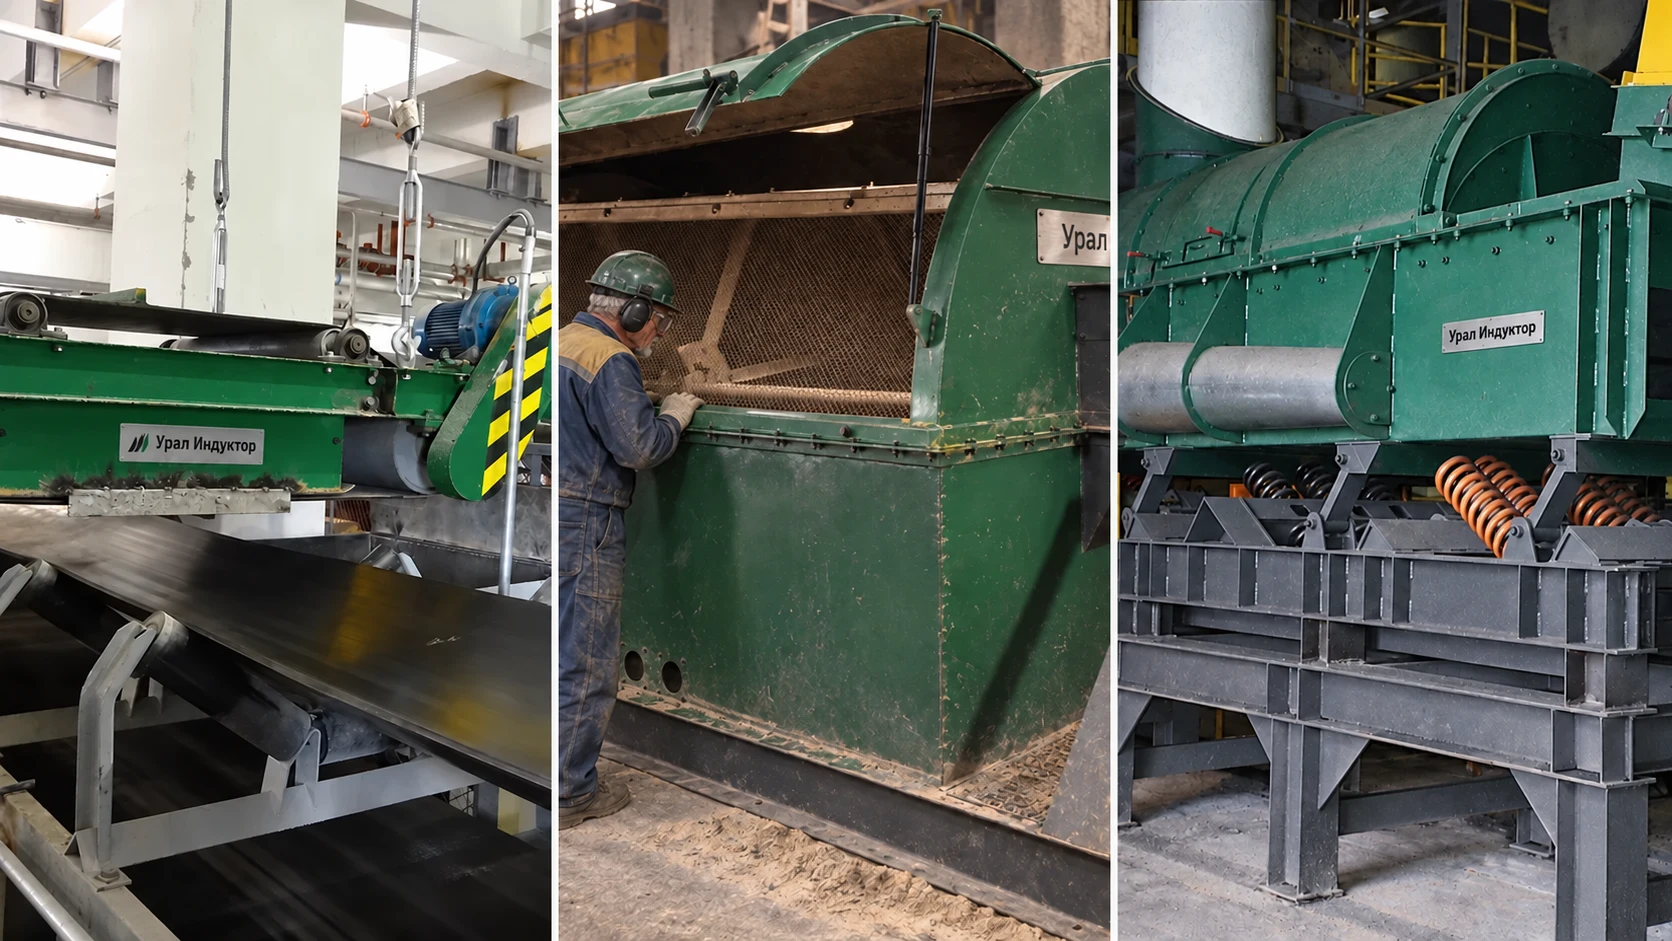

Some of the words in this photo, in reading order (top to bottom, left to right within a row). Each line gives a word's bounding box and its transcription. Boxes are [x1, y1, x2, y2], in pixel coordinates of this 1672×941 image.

[1061, 223, 1107, 256] Урал
[1448, 329, 1476, 345] Урал
[1479, 322, 1536, 340] Индуктор
[156, 435, 190, 453] Урал
[193, 436, 257, 455] Индуктор
